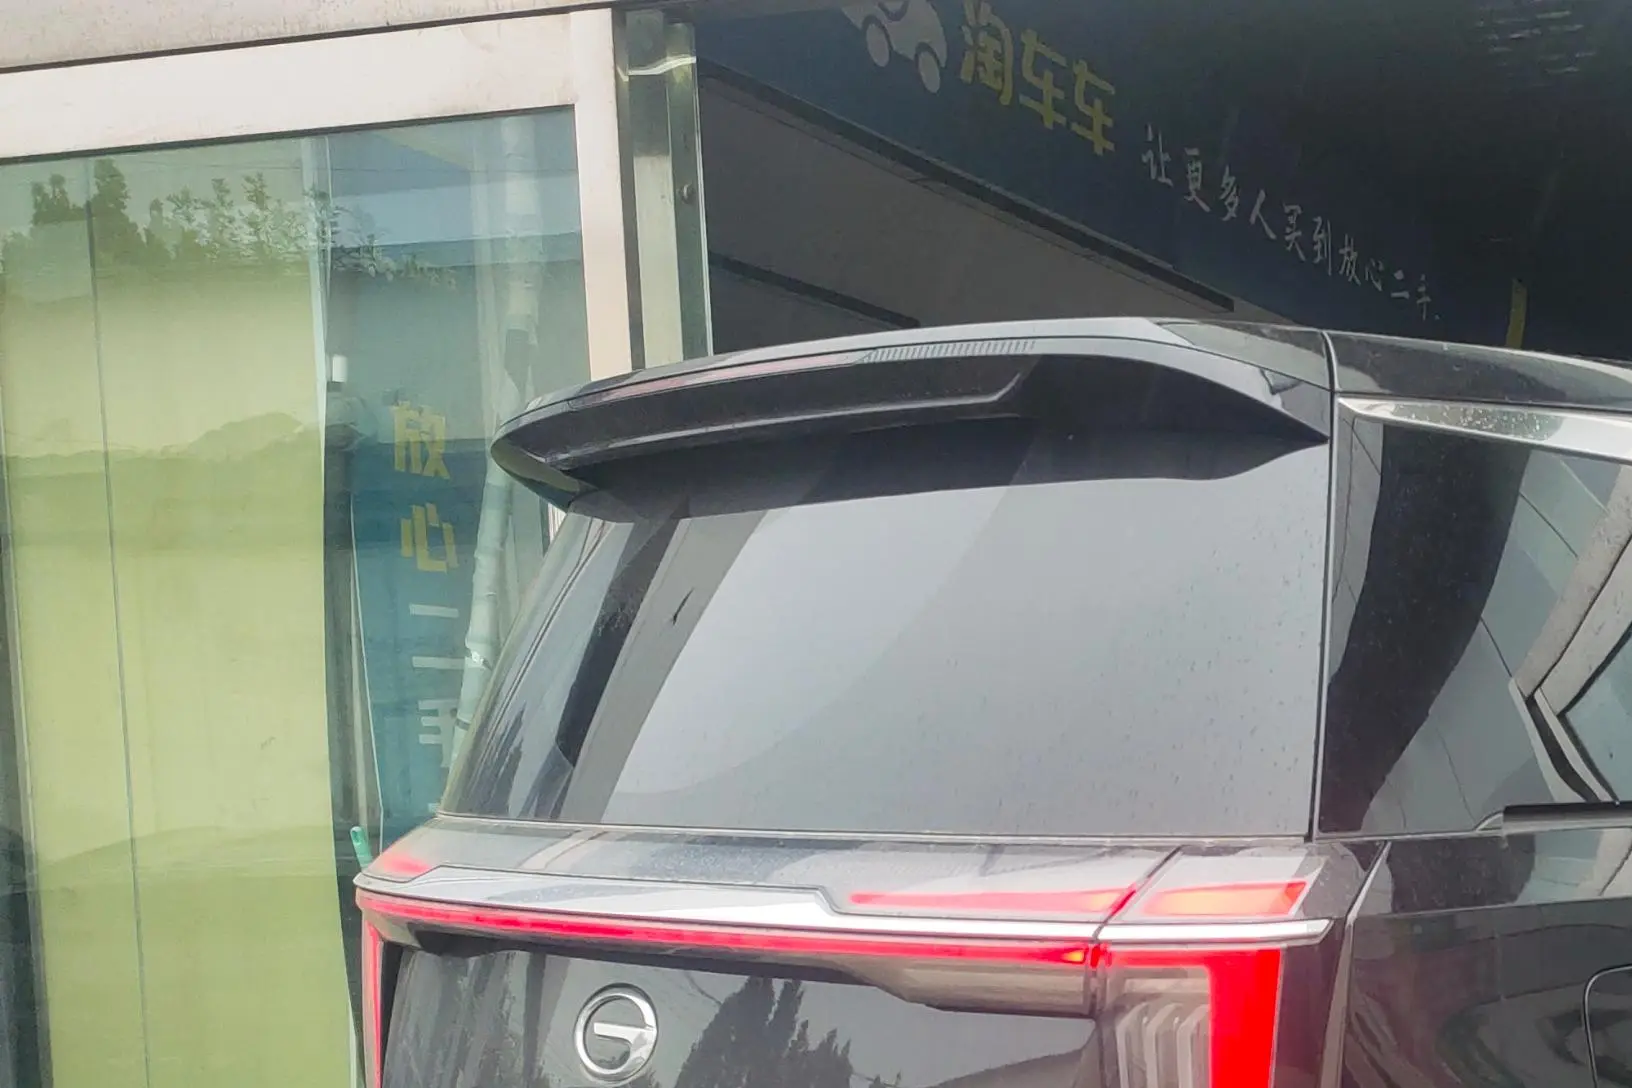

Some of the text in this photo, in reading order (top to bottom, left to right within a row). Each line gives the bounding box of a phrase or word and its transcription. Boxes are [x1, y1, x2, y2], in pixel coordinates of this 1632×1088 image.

[959, 0, 1116, 156] 淘车车
[390, 400, 462, 813] 放心二手
